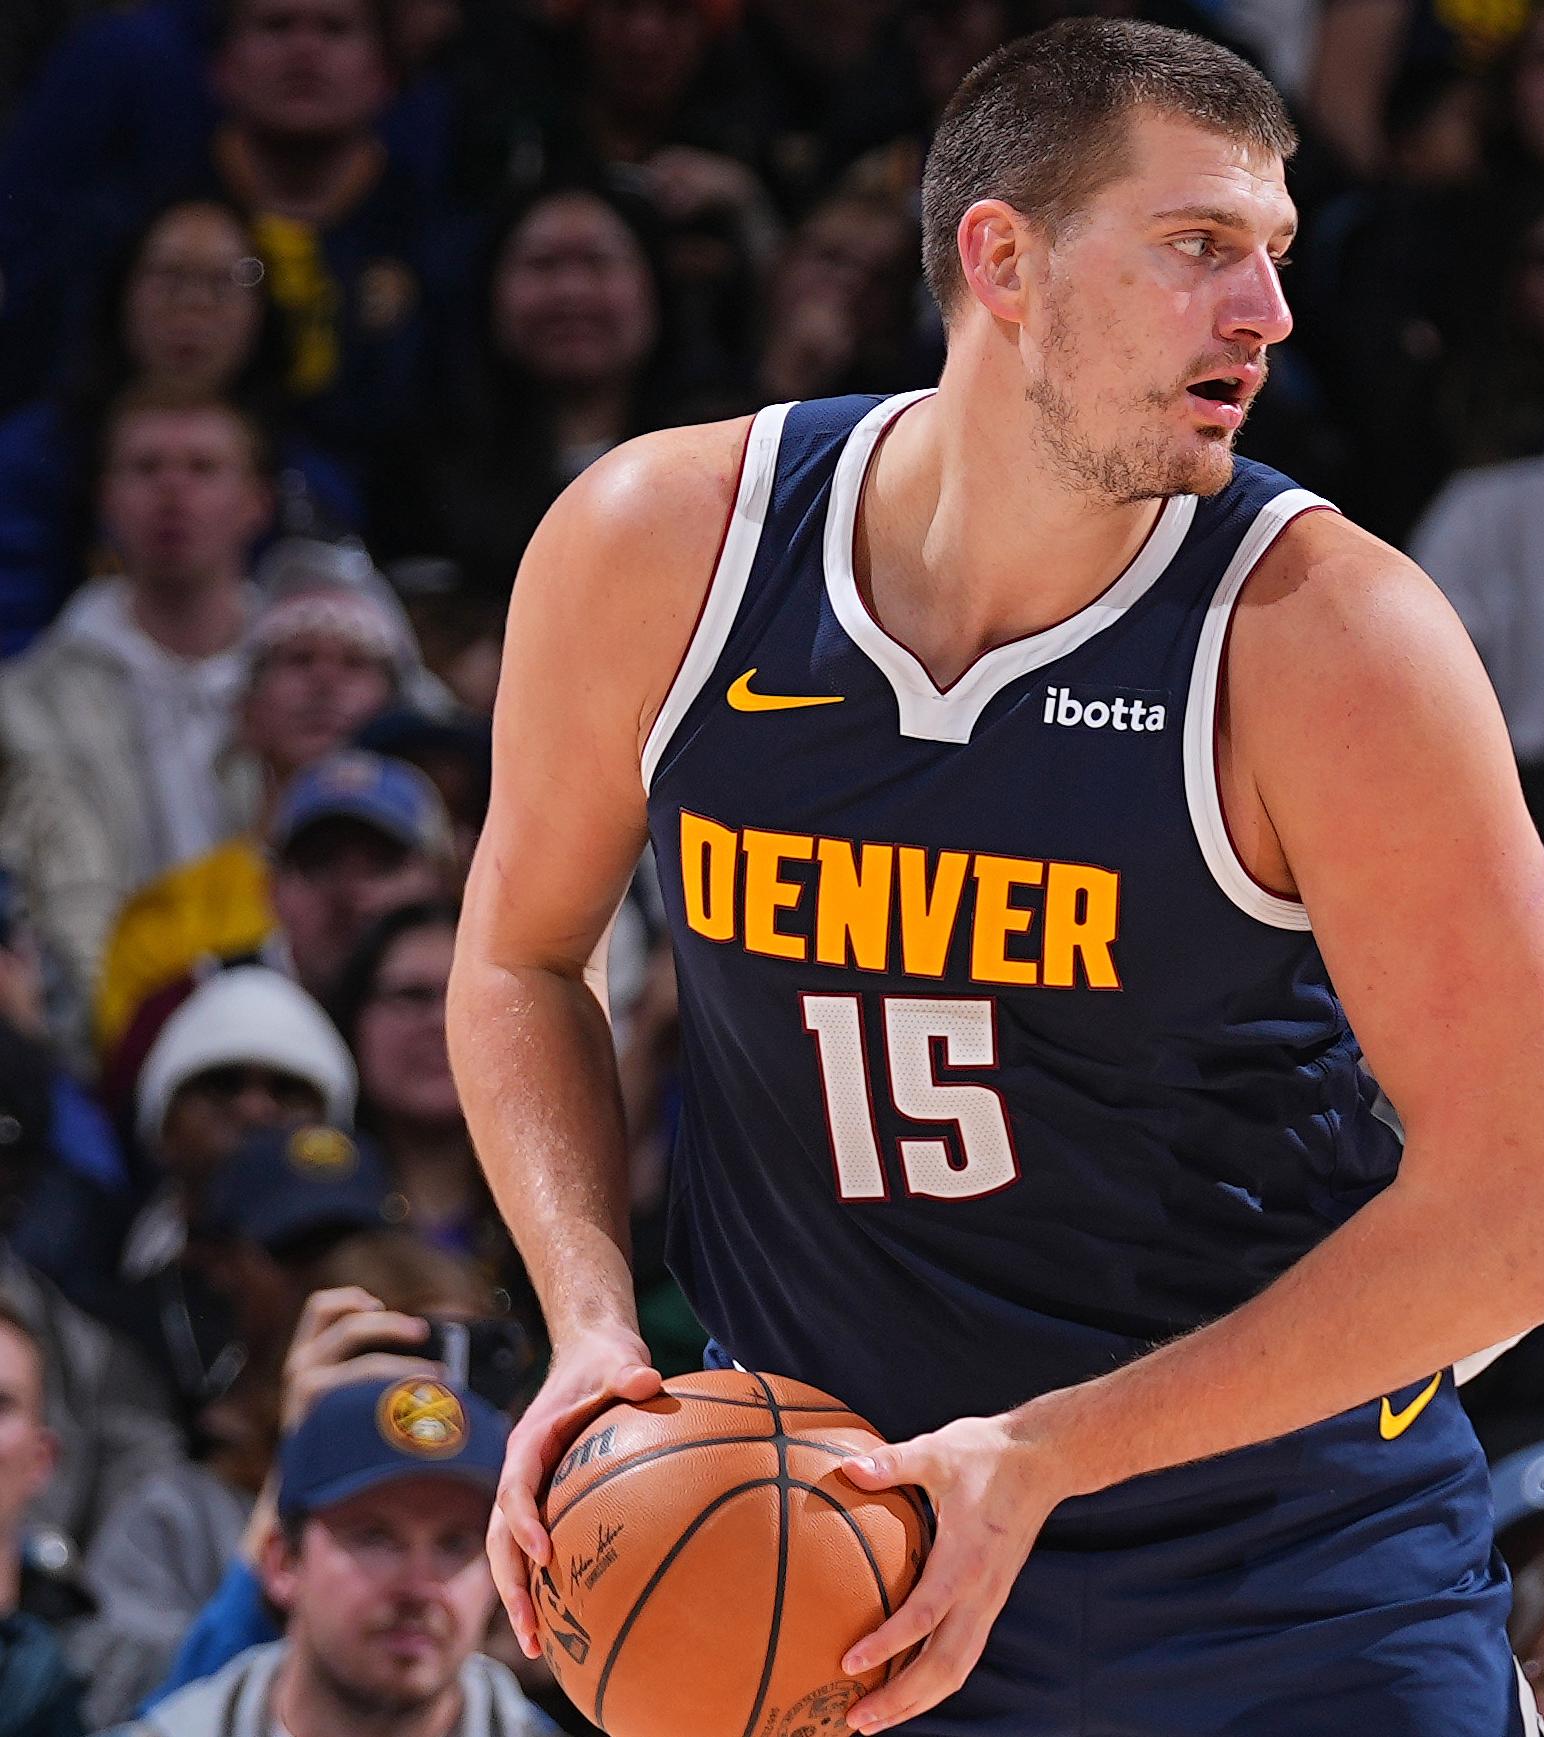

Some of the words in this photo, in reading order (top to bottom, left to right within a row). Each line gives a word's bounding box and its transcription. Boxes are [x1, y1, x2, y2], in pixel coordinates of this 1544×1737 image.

[1043, 685, 1167, 732] ibotta
[679, 806, 1123, 992] DENVER
[799, 992, 1021, 1204] 15
